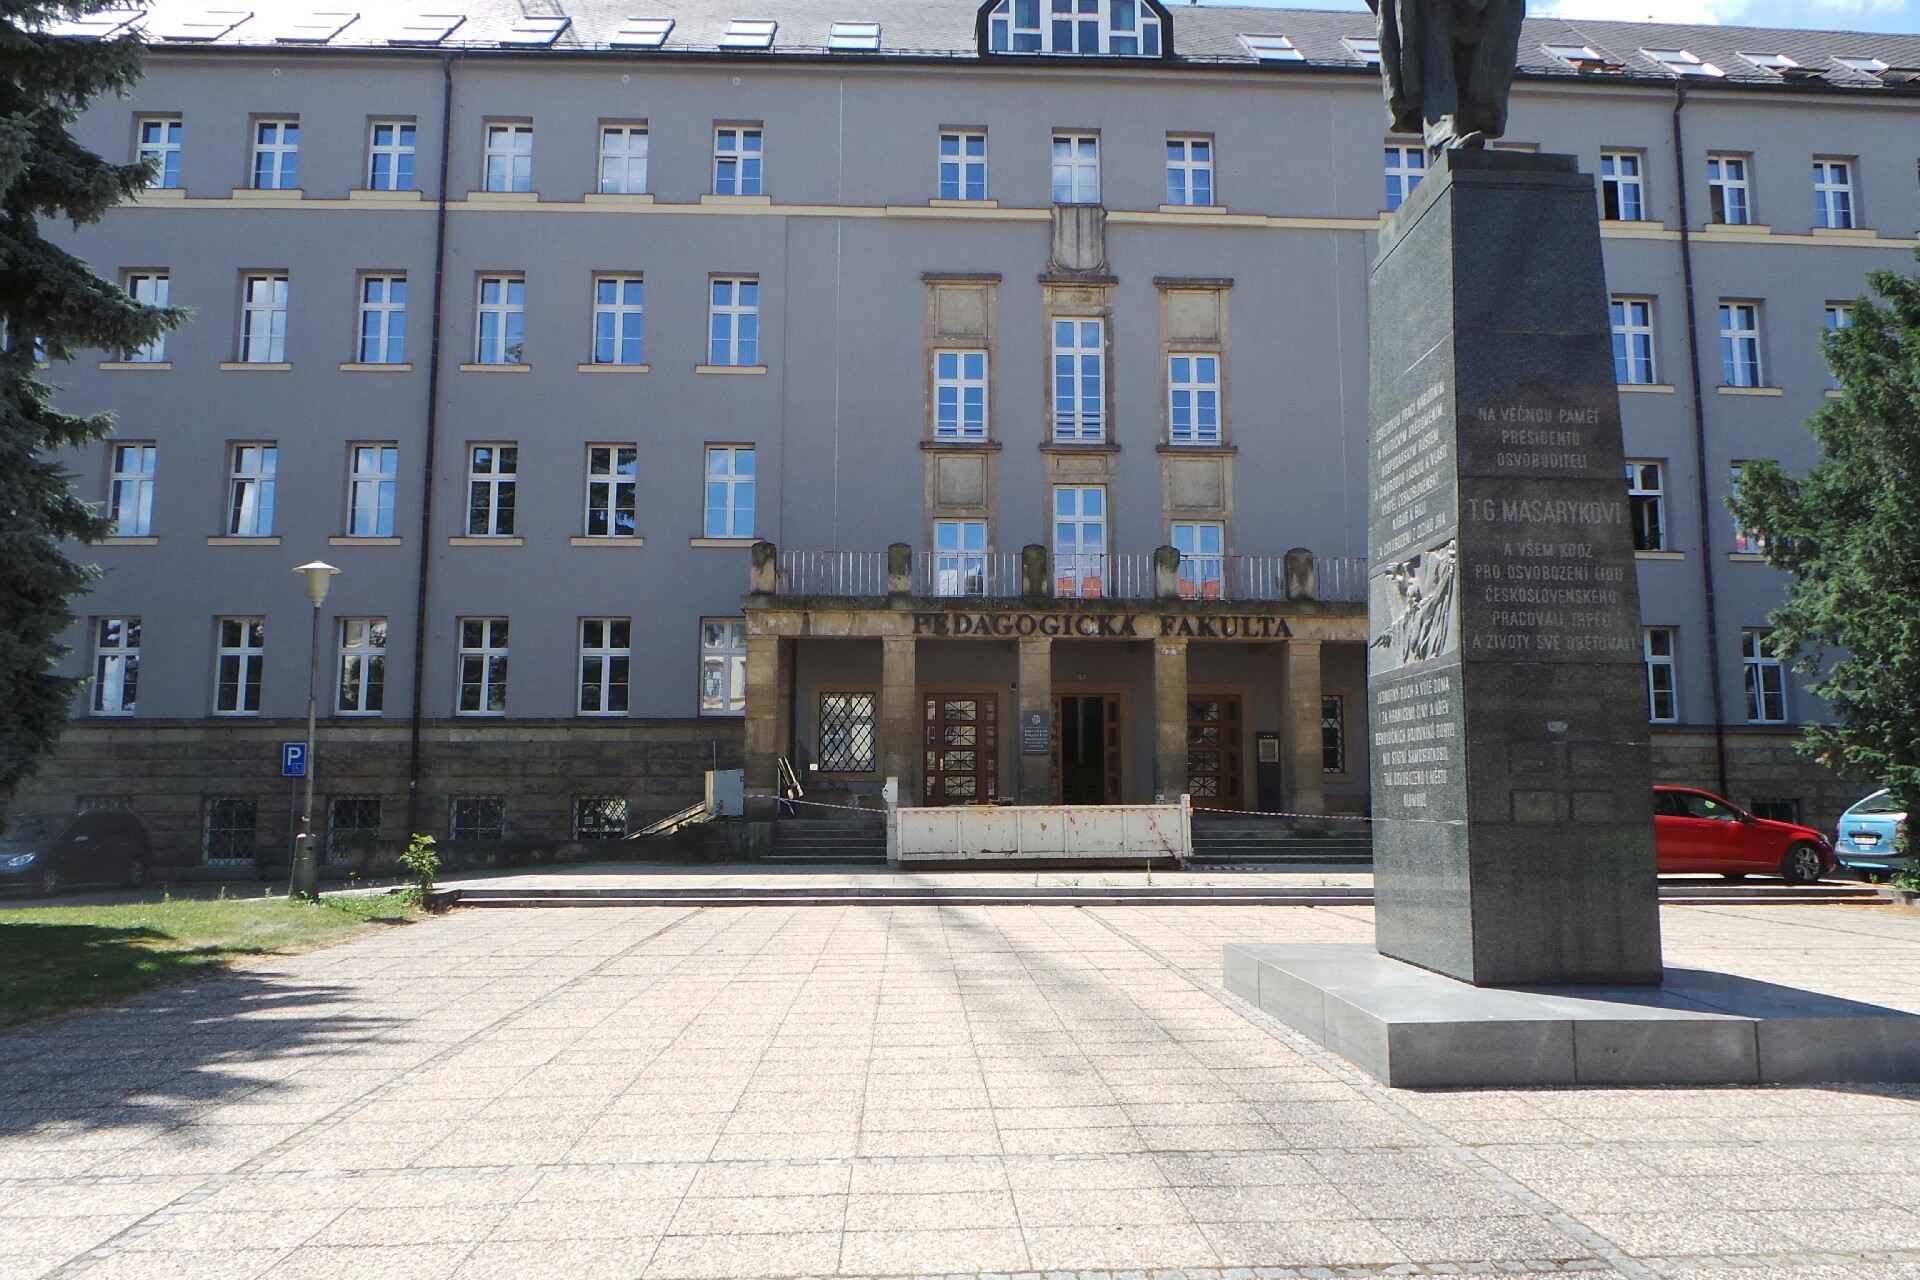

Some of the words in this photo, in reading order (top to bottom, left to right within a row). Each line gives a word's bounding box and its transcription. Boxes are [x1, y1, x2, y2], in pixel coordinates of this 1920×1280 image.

[1478, 408, 1496, 421] NA
[1502, 430, 1580, 446] PRESIDENTU
[1497, 452, 1587, 469] OSVOBODITELI
[1502, 500, 1622, 524] MASARYKOVI
[1503, 544, 1512, 556] A
[1475, 564, 1500, 579] PRO
[1159, 615, 1293, 638] FAKULTA
[1472, 635, 1481, 649] A
[287, 746, 301, 766] P
